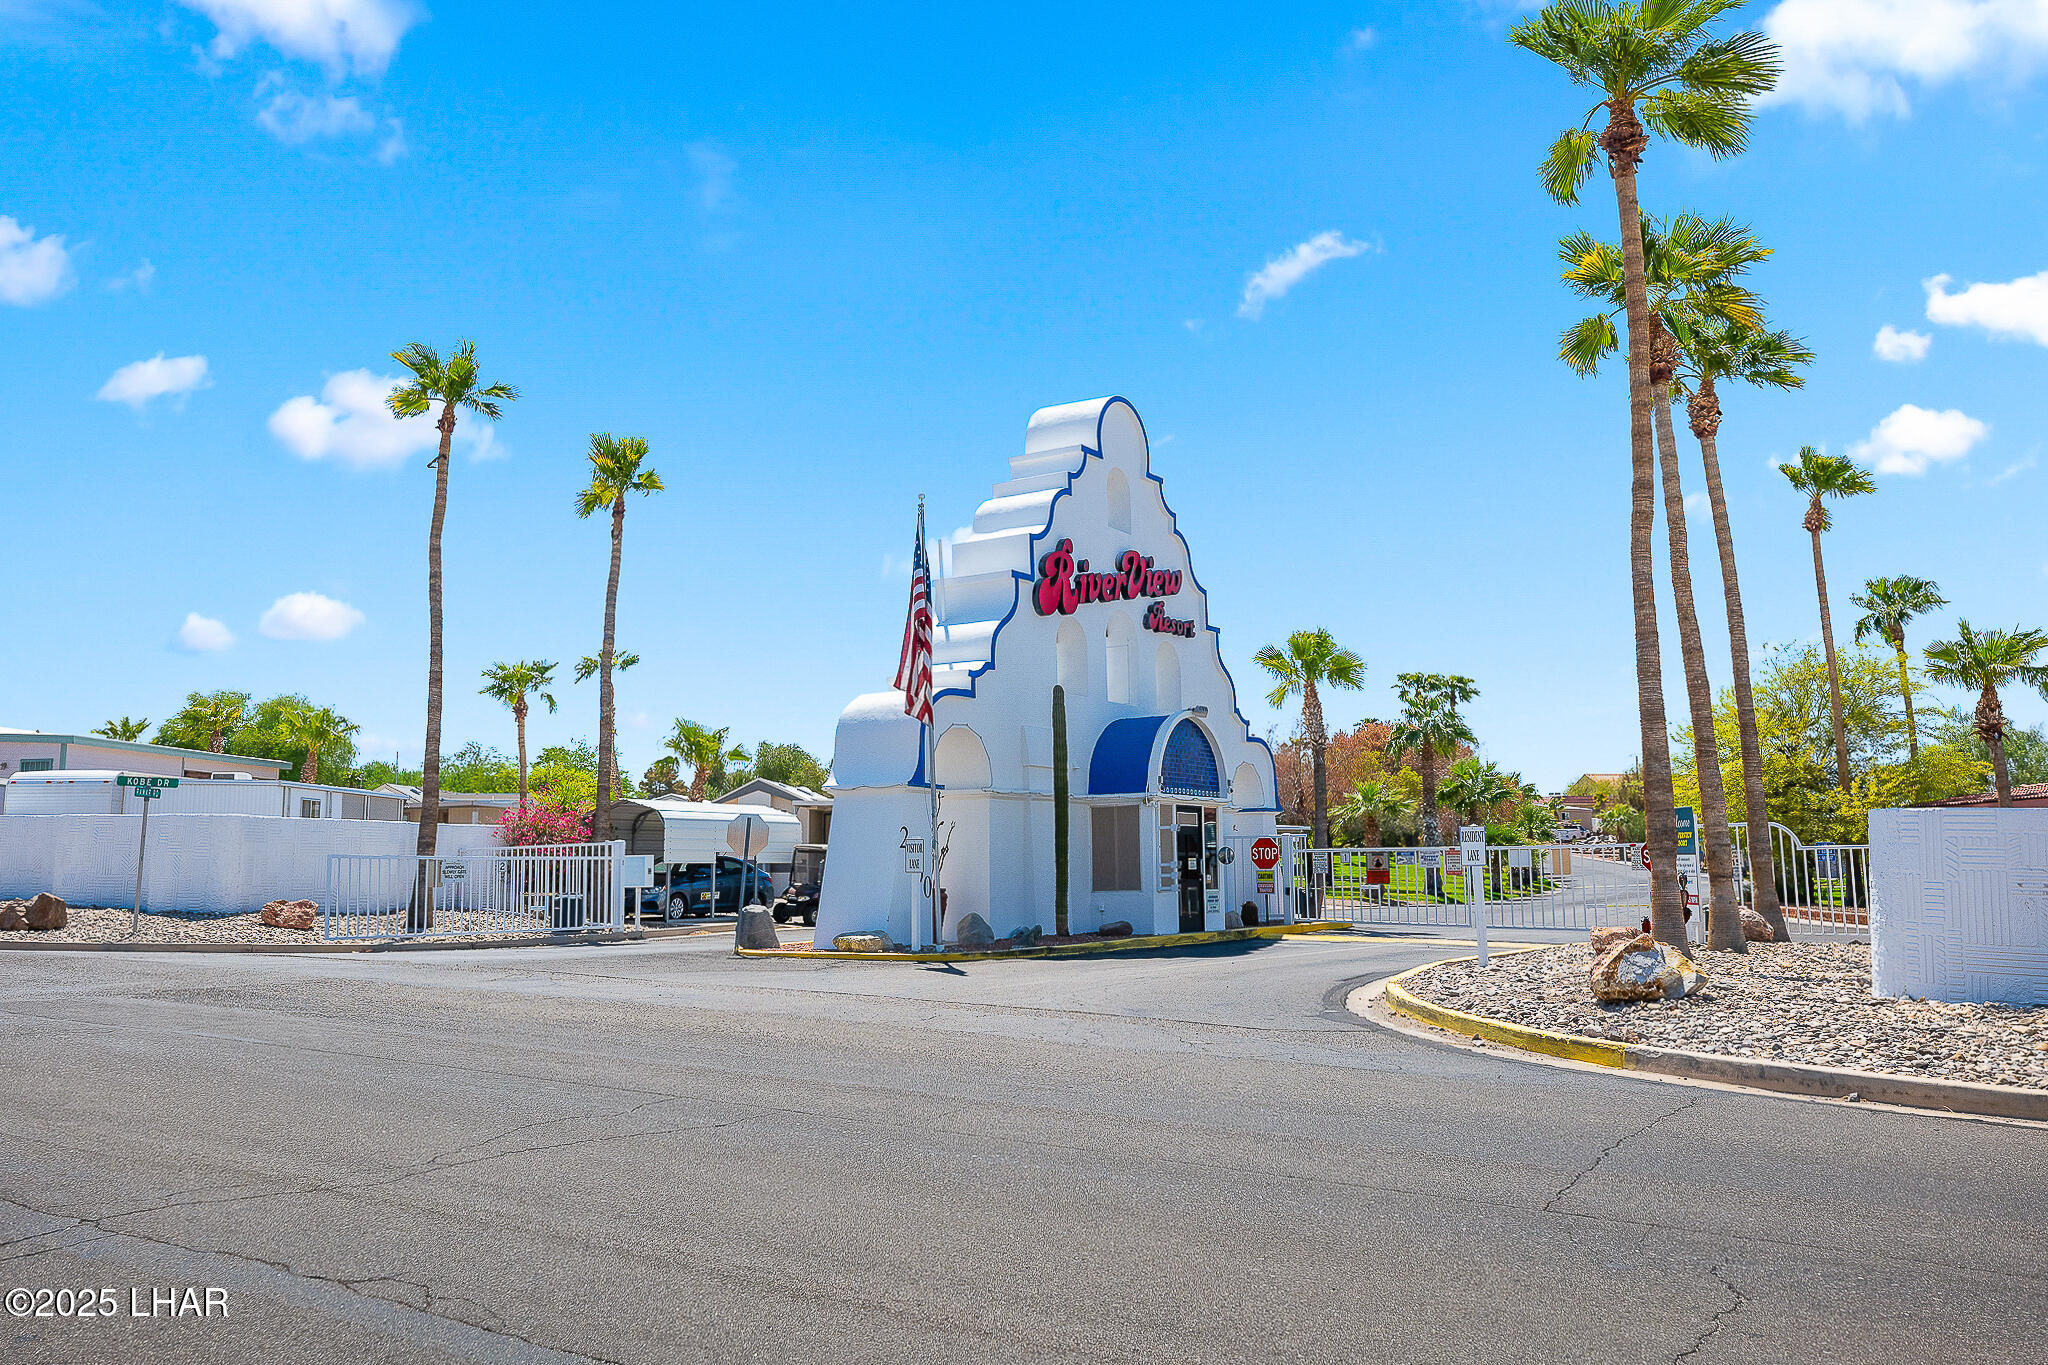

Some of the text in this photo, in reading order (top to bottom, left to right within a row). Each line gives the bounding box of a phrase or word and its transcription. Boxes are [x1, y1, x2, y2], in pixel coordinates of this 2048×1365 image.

[1034, 538, 1182, 616] RiverView
[1143, 601, 1195, 638] Resort
[127, 777, 170, 787] KOBE DR
[1461, 831, 1485, 842] RESIDENT
[906, 843, 923, 853] VISITOR
[1253, 849, 1277, 860] STOP
[1467, 849, 1480, 861] LANE
[909, 858, 919, 869] LANE
